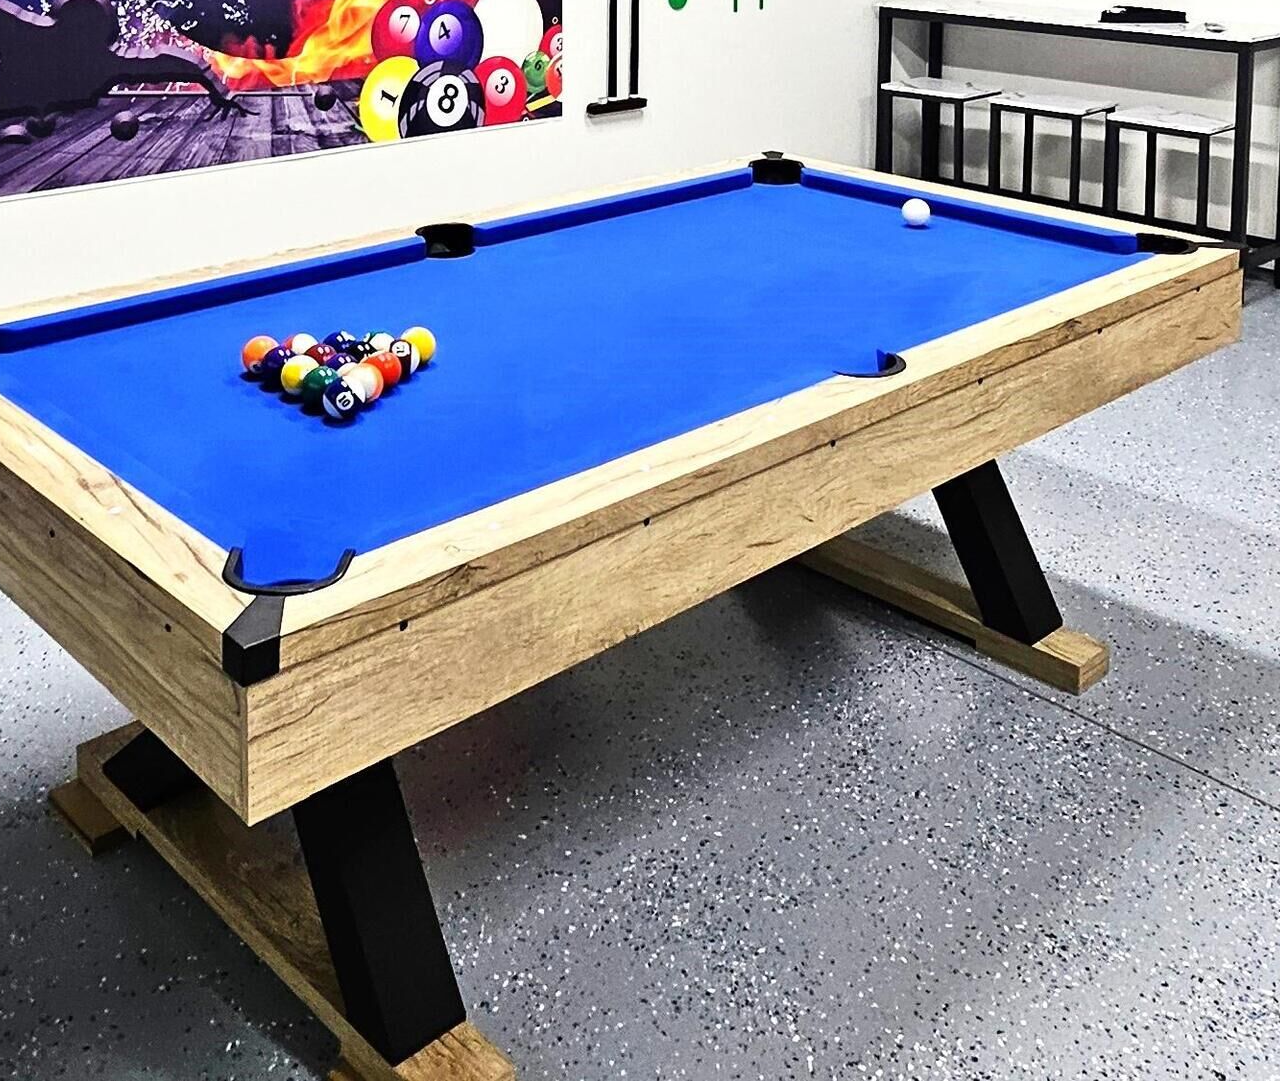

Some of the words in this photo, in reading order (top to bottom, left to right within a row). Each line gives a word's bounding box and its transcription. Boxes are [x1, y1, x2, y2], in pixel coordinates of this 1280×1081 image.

[399, 14, 411, 35] 7
[438, 21, 451, 42] 4
[534, 59, 543, 71] 6
[494, 75, 509, 95] 3
[380, 89, 399, 108] 1
[437, 83, 459, 114] 8
[337, 394, 352, 408] 10
